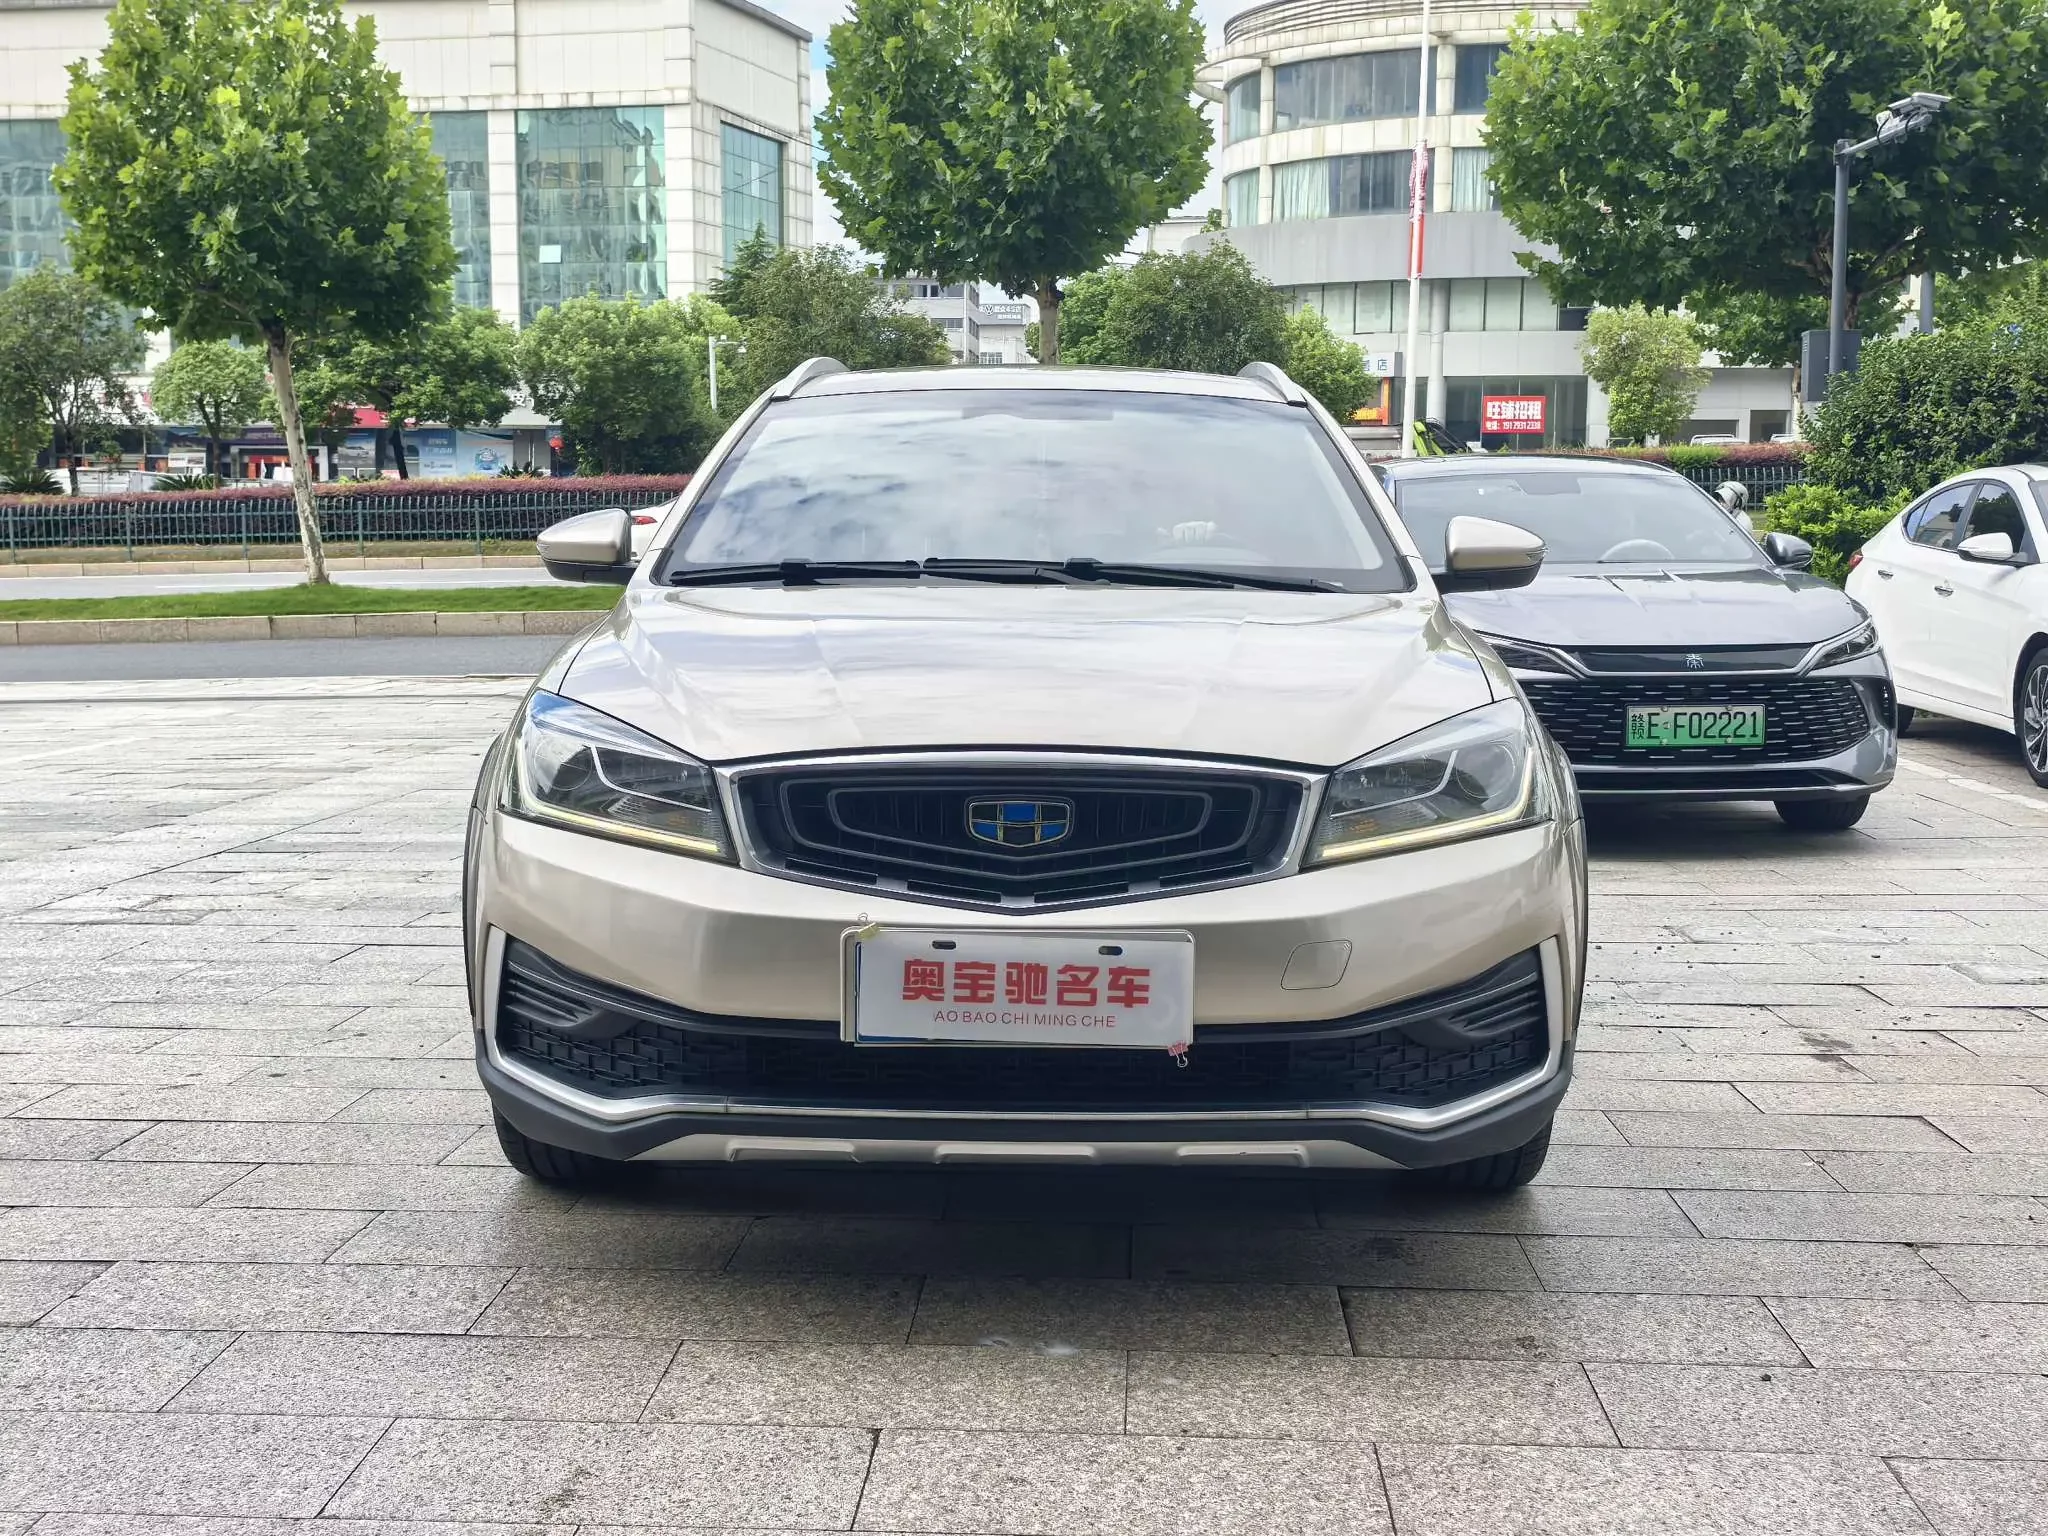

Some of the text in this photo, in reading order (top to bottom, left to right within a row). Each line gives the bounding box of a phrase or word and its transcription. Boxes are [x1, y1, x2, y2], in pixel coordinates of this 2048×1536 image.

[1487, 401, 1542, 420] 旺铺招租
[902, 958, 1151, 1009] 奥宝驰名车
[934, 1010, 1116, 1028] AO BAO CHI MING CHE
